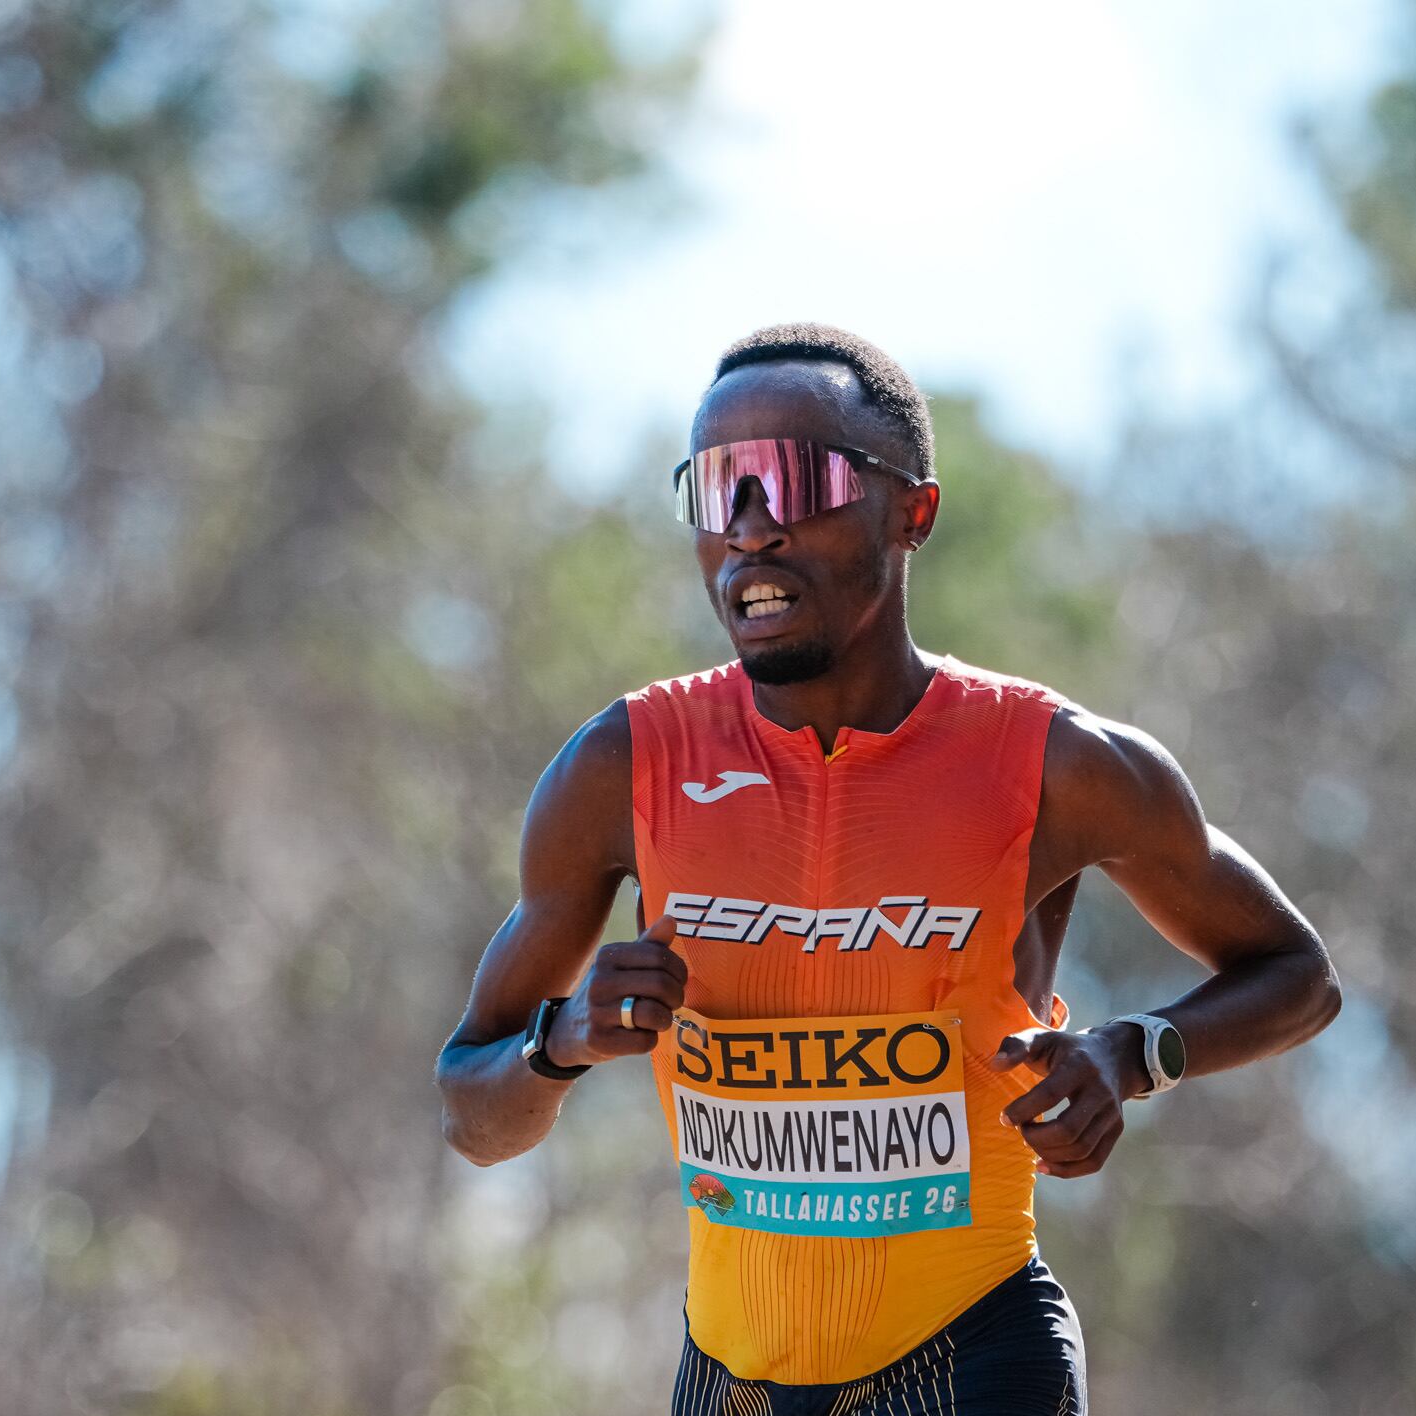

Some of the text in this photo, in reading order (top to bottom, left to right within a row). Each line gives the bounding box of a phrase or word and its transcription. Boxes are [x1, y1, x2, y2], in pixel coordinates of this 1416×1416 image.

[663, 891, 982, 953] ESPAÑA
[676, 1021, 951, 1089] SEIKO
[679, 1095, 956, 1173] NDIKUMWENAYO
[743, 1185, 957, 1223] TALLAHASSEE 26
